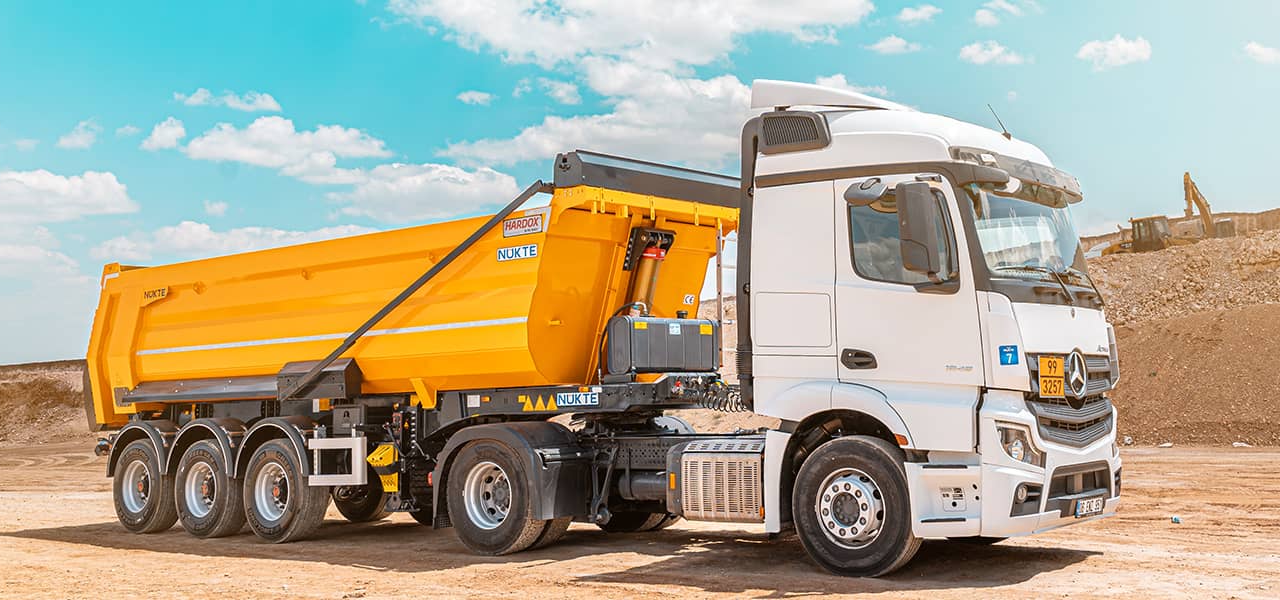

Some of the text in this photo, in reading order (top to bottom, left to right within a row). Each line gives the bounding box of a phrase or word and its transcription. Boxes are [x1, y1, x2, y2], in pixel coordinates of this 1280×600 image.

[505, 217, 539, 230] HARDOX
[1006, 353, 1012, 364] 7
[1047, 360, 1057, 374] 99
[1043, 379, 1061, 394] 3257
